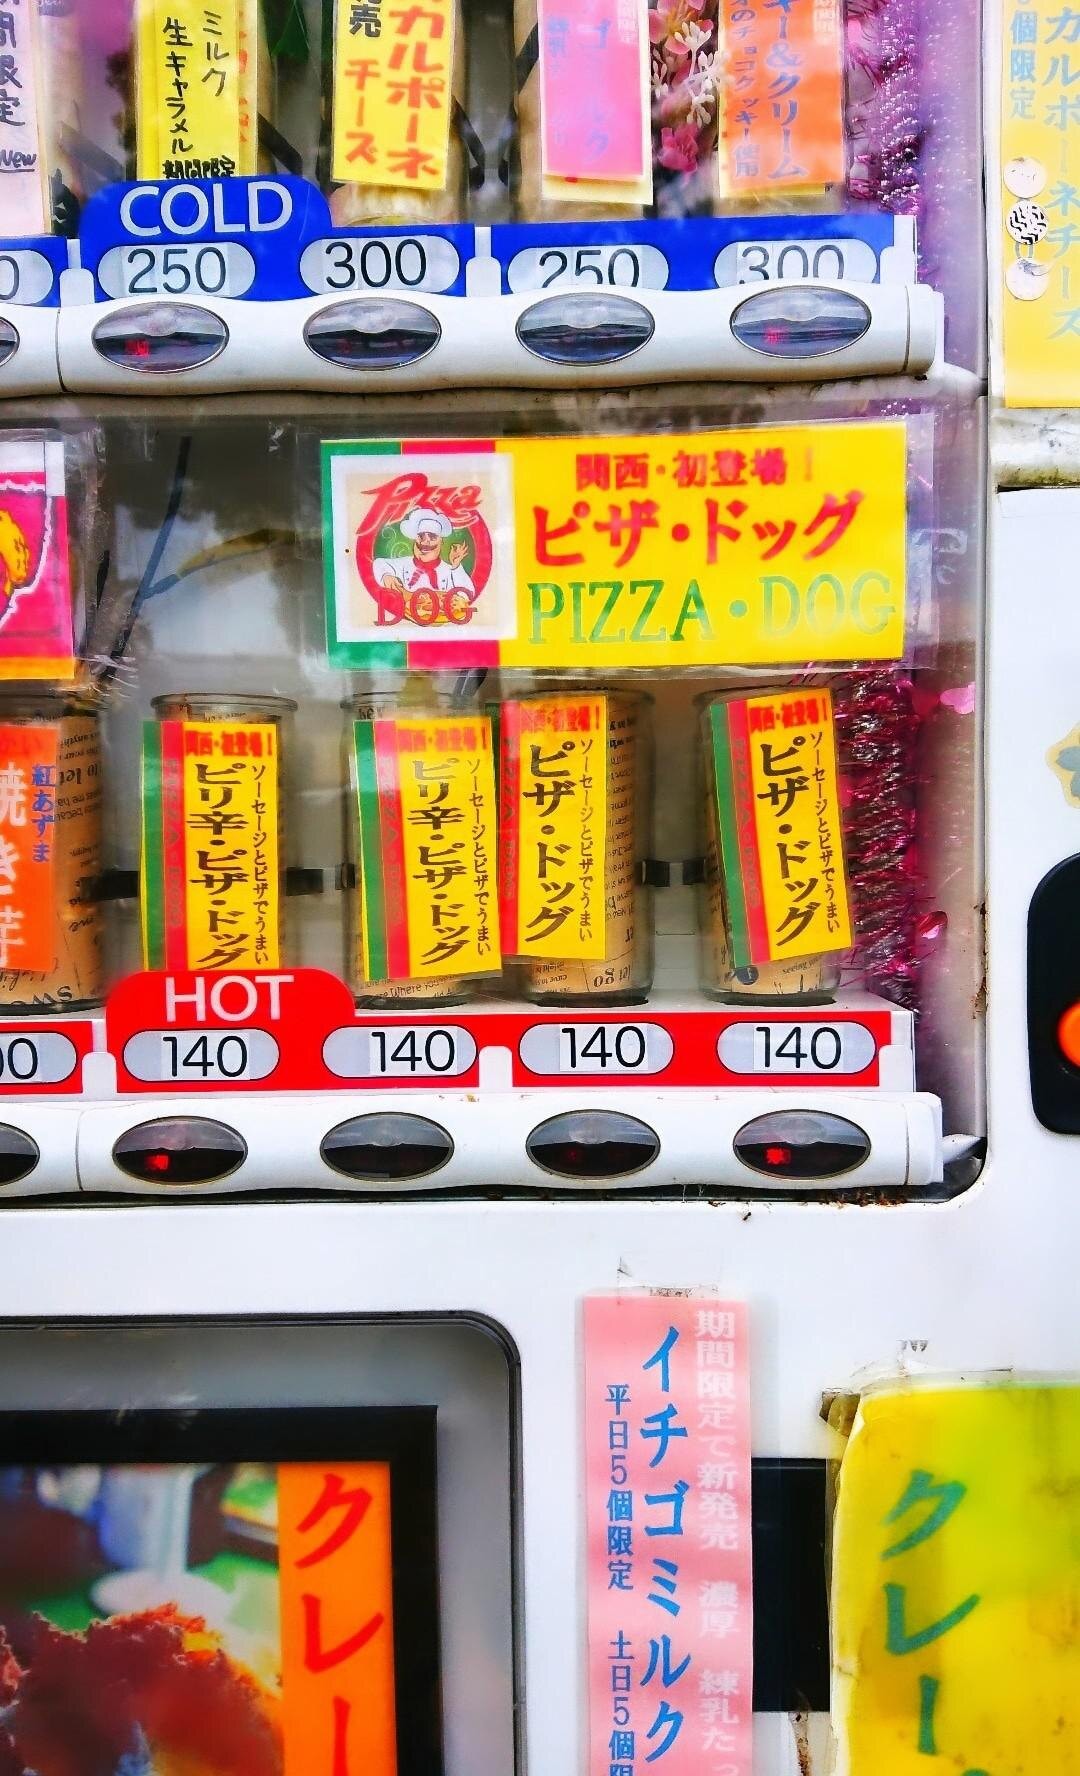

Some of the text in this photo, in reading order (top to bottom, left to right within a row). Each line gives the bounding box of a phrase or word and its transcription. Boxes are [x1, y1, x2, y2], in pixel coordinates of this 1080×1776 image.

[202, 10, 229, 97] ミルク
[350, 0, 381, 37] 売
[1009, 0, 1038, 119] 個限定
[163, 17, 193, 154] 生キャラメル
[345, 59, 381, 164] チーズ
[731, 0, 760, 177] のチョコクッキー使用
[120, 181, 292, 236] COLD
[127, 247, 227, 294] 250
[326, 239, 427, 288] 300
[539, 248, 640, 289] 250
[739, 244, 845, 285] 300
[356, 472, 483, 535] Pizza
[533, 489, 866, 568] ピザ・ドッグ
[374, 586, 478, 627] DOG
[251, 765, 270, 965] ソーセージとピザでうまい
[466, 758, 492, 956] ソーセージとピザでうまい
[522, 740, 576, 942] ピザ・ドッグ
[579, 738, 594, 942] ソーセージとピザでうまい
[757, 735, 821, 947] ピザ・ドッグ
[811, 731, 840, 934] ソーセージとピザでうまい
[165, 974, 294, 1022] HOT
[0, 1037, 38, 1080] 0
[162, 1034, 248, 1078] 140
[371, 1029, 455, 1073] 140
[561, 1025, 646, 1069] 140
[755, 1026, 841, 1070] 140
[694, 1311, 739, 1550] 期間限定で新発売
[605, 1383, 634, 1591] 平日5個限定
[639, 1325, 692, 1763] イチゴミルク
[294, 1473, 385, 1776] クレー
[880, 1468, 990, 1776] クレー
